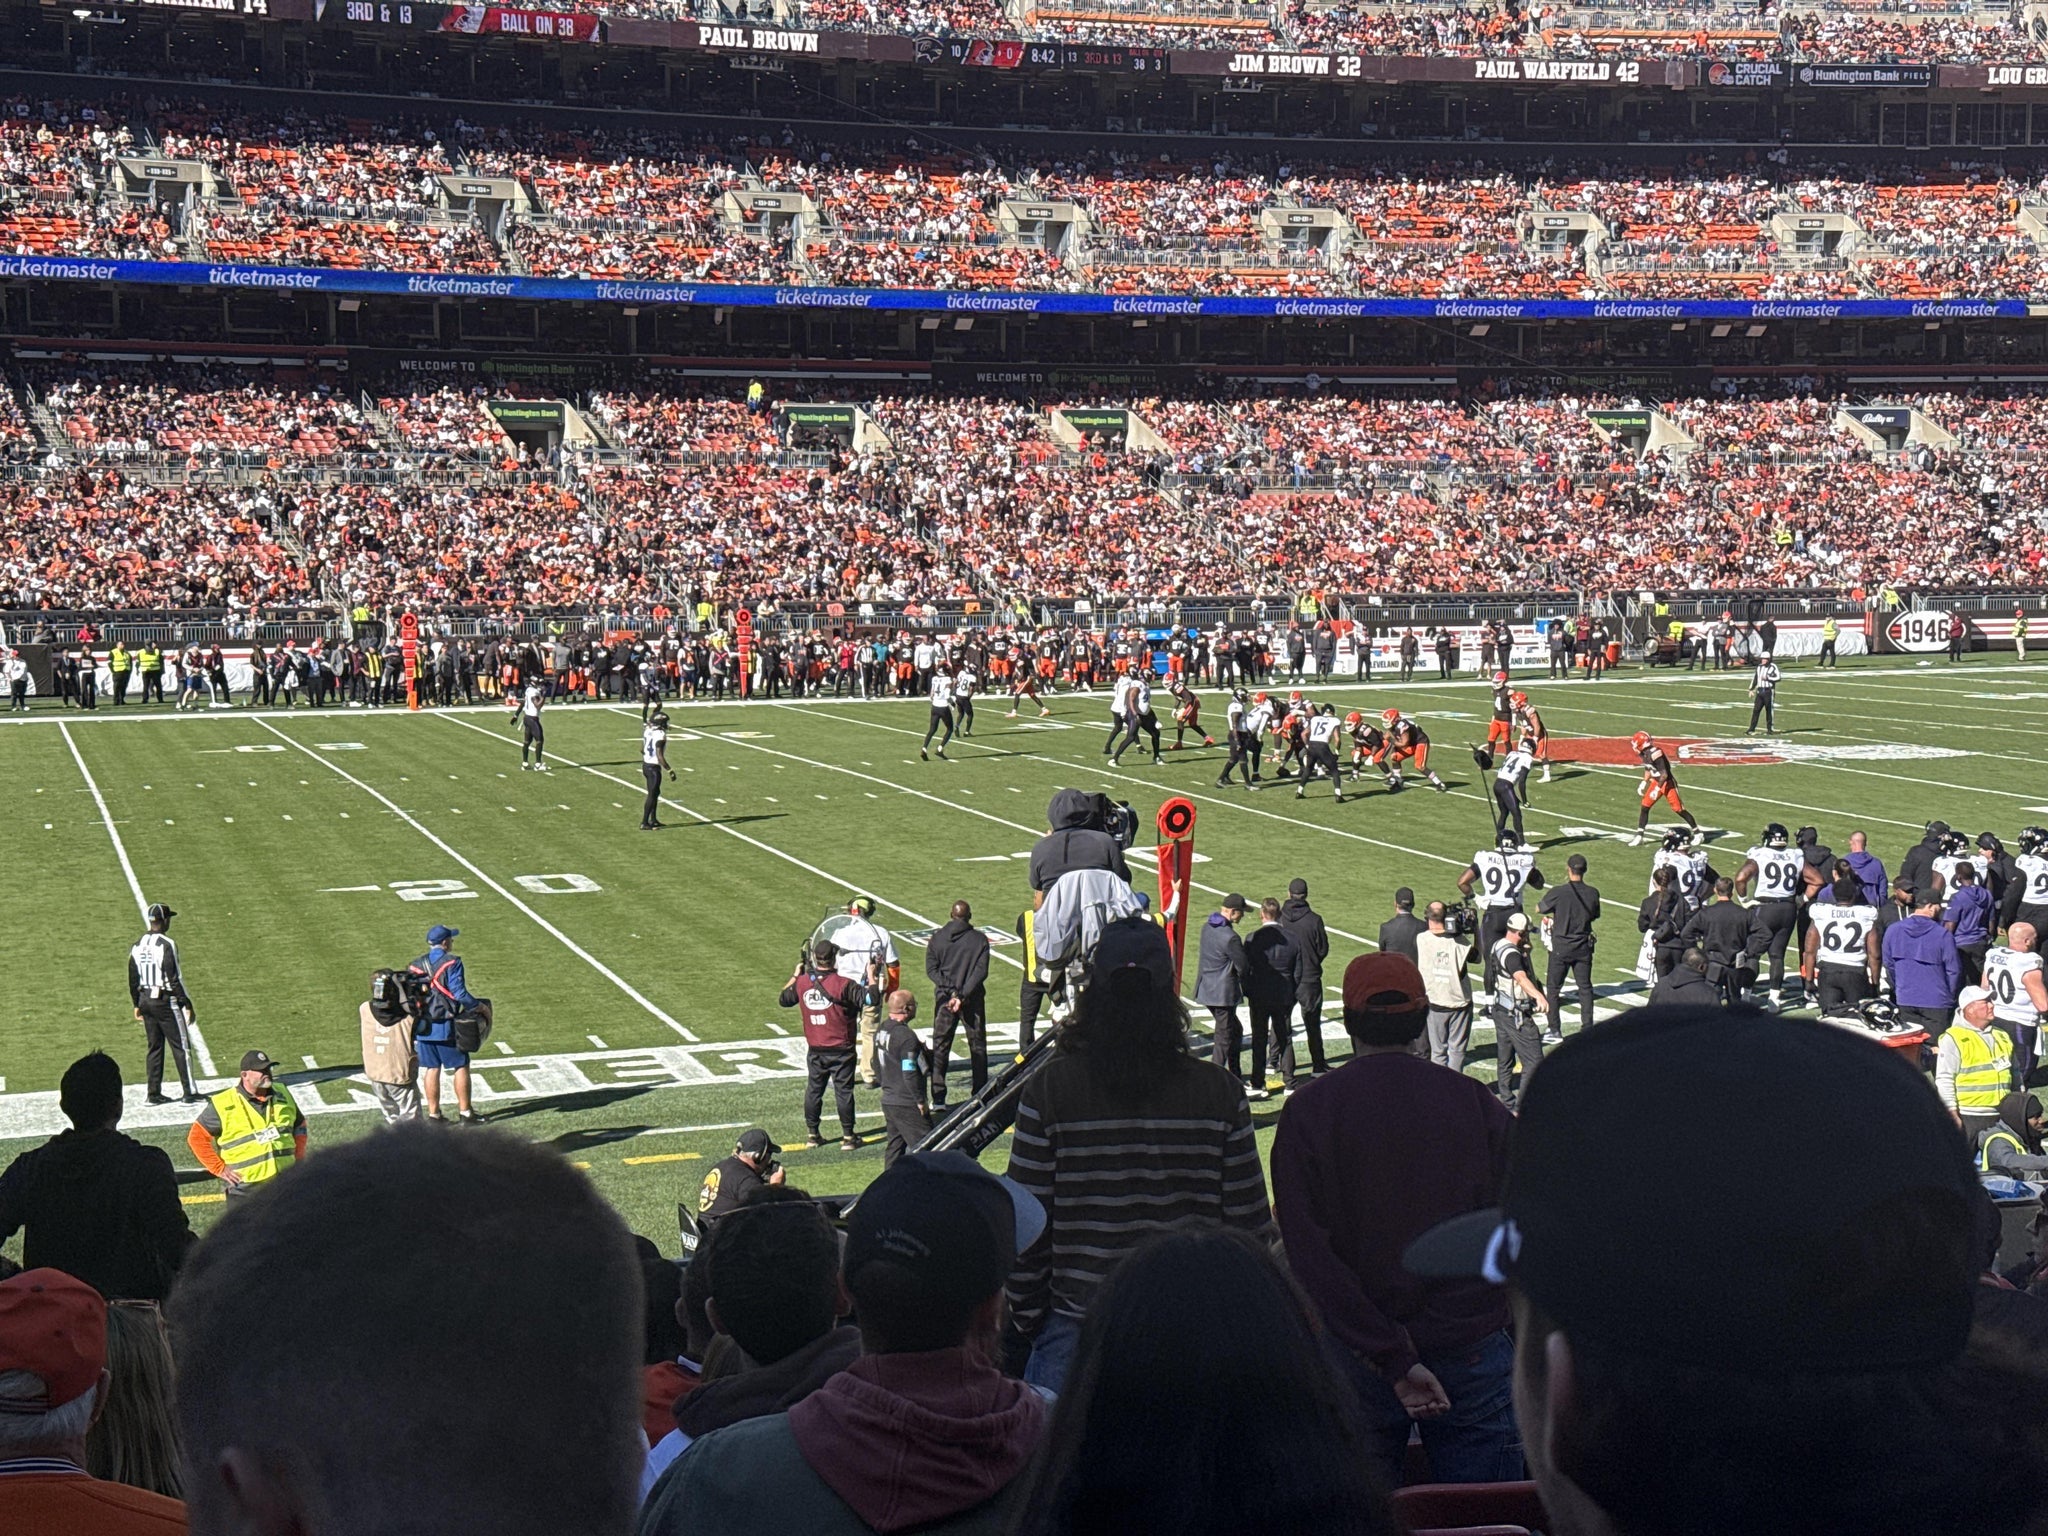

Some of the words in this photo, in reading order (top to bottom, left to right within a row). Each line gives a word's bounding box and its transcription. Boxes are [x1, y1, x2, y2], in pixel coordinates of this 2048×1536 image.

[347, 2, 374, 21] 3RD
[380, 6, 390, 22] &
[400, 6, 412, 24] 13
[501, 13, 529, 33] BALL
[536, 17, 554, 34] ON
[558, 18, 574, 36] 38
[699, 26, 748, 48] PAUL
[752, 29, 819, 53] BROWN
[951, 45, 962, 58] 10
[1031, 49, 1056, 64] 8:42
[1068, 51, 1078, 63] 13
[1133, 58, 1146, 70] 38
[1154, 59, 1162, 71] 3
[1229, 54, 1264, 73] JIM
[1268, 57, 1329, 75] BROWN
[1337, 56, 1361, 76] 32
[1475, 60, 1519, 79] PAUL
[1524, 61, 1610, 81] WARFIELD
[1615, 62, 1640, 82] 42
[1735, 63, 1783, 75] CRUCIAL
[1735, 74, 1773, 86] CATCH
[1815, 70, 1872, 84] Huntington
[1873, 69, 1900, 82] Bank
[1903, 72, 1931, 80] FIELD
[1988, 67, 2022, 84] LOU
[209, 266, 322, 288] ticketmaster
[408, 275, 514, 296] ticketmaster
[596, 283, 697, 302] ticketmaster
[775, 289, 872, 307] ticketmaster
[946, 293, 1040, 310] ticketmaster
[1113, 297, 1203, 315] ticketmaster
[1275, 300, 1365, 316] ticketmaster
[1435, 301, 1523, 318] ticketmaster
[1594, 302, 1682, 318] ticketmaster
[1751, 302, 1842, 318] ticketmaster
[1911, 301, 2000, 318] ticketmaster
[400, 360, 457, 371] WELCOME
[461, 361, 475, 372] TO
[496, 363, 550, 375] Huntington
[551, 364, 575, 374] Bank
[977, 373, 1027, 383] WELCOME
[1031, 373, 1043, 382] TO
[1904, 619, 1948, 643] 1946
[1370, 660, 1399, 669] LEVELAND
[1524, 656, 1549, 666] BROWNS
[1313, 720, 1327, 736] 15
[1486, 867, 1521, 898] 92
[1765, 862, 1798, 892] 98
[1823, 921, 1863, 953] 62
